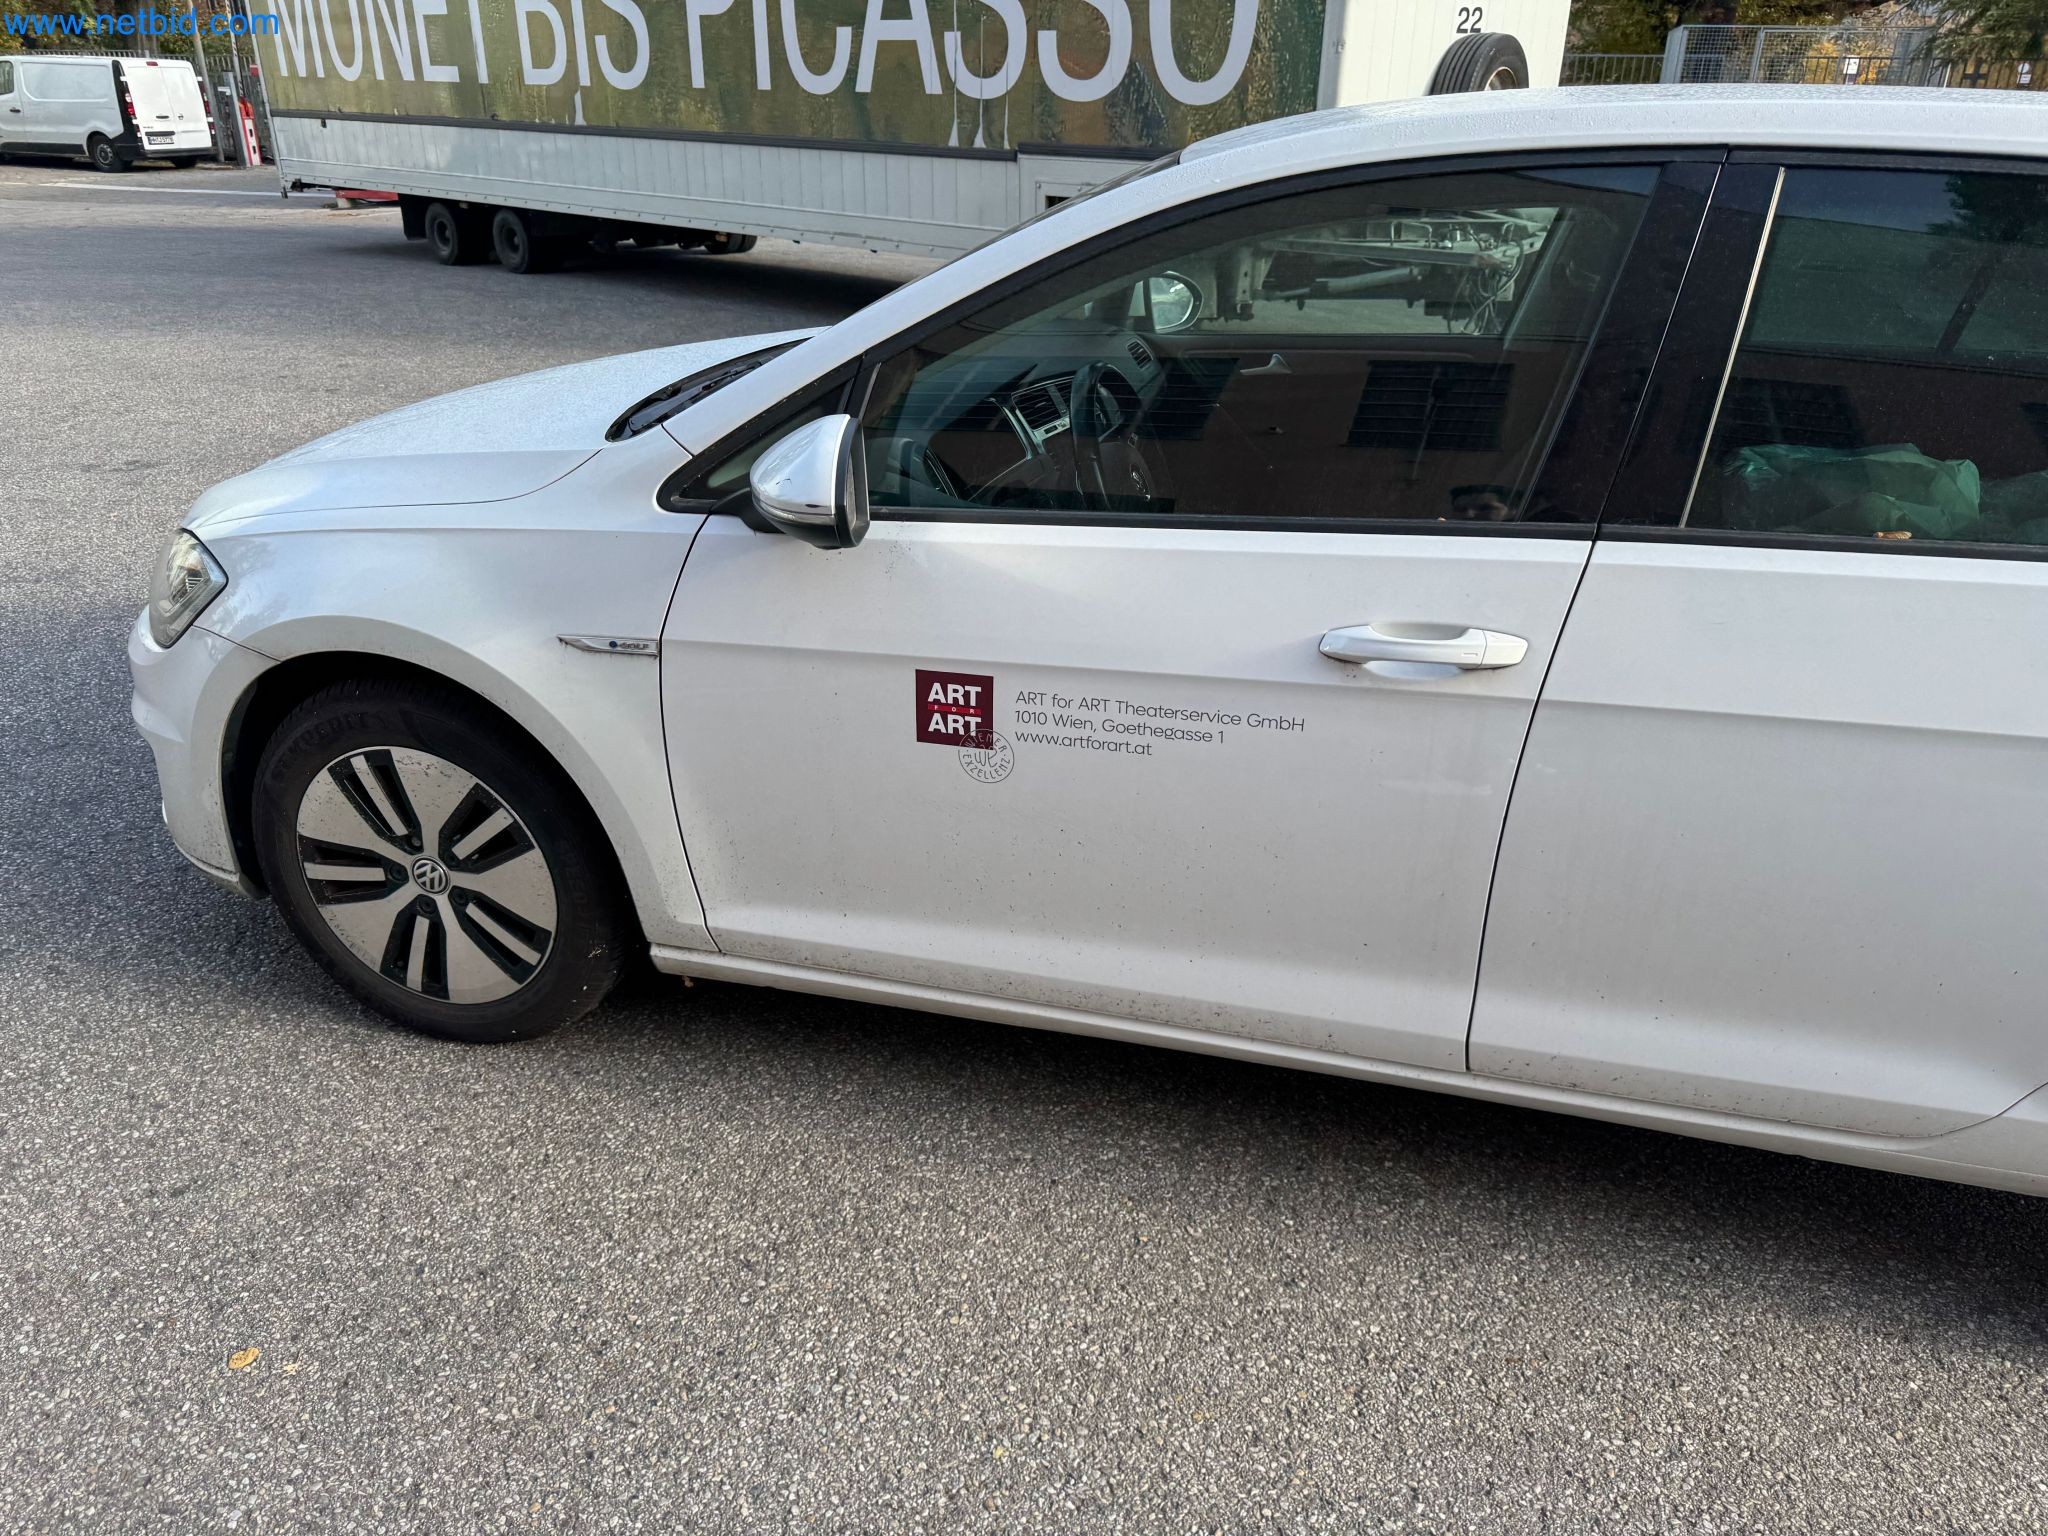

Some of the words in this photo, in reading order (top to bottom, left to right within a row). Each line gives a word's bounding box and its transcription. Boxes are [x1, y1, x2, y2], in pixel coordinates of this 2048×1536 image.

[1456, 7, 1483, 34] 22
[927, 682, 982, 707] ART
[934, 704, 975, 715] FOR
[1015, 690, 1047, 706] ART
[1052, 693, 1074, 709] for
[1078, 697, 1111, 713] ART
[1115, 700, 1242, 726] Theaterservice
[1246, 713, 1305, 732] GmbH
[927, 712, 982, 737] ART
[1015, 710, 1048, 726] 1010
[1052, 713, 1097, 733] Wien,
[1101, 719, 1213, 743] Goethegasse
[1218, 730, 1224, 744] 1
[1015, 731, 1153, 756] www.artforart.at
[962, 753, 1011, 780] EXZELLENZ
